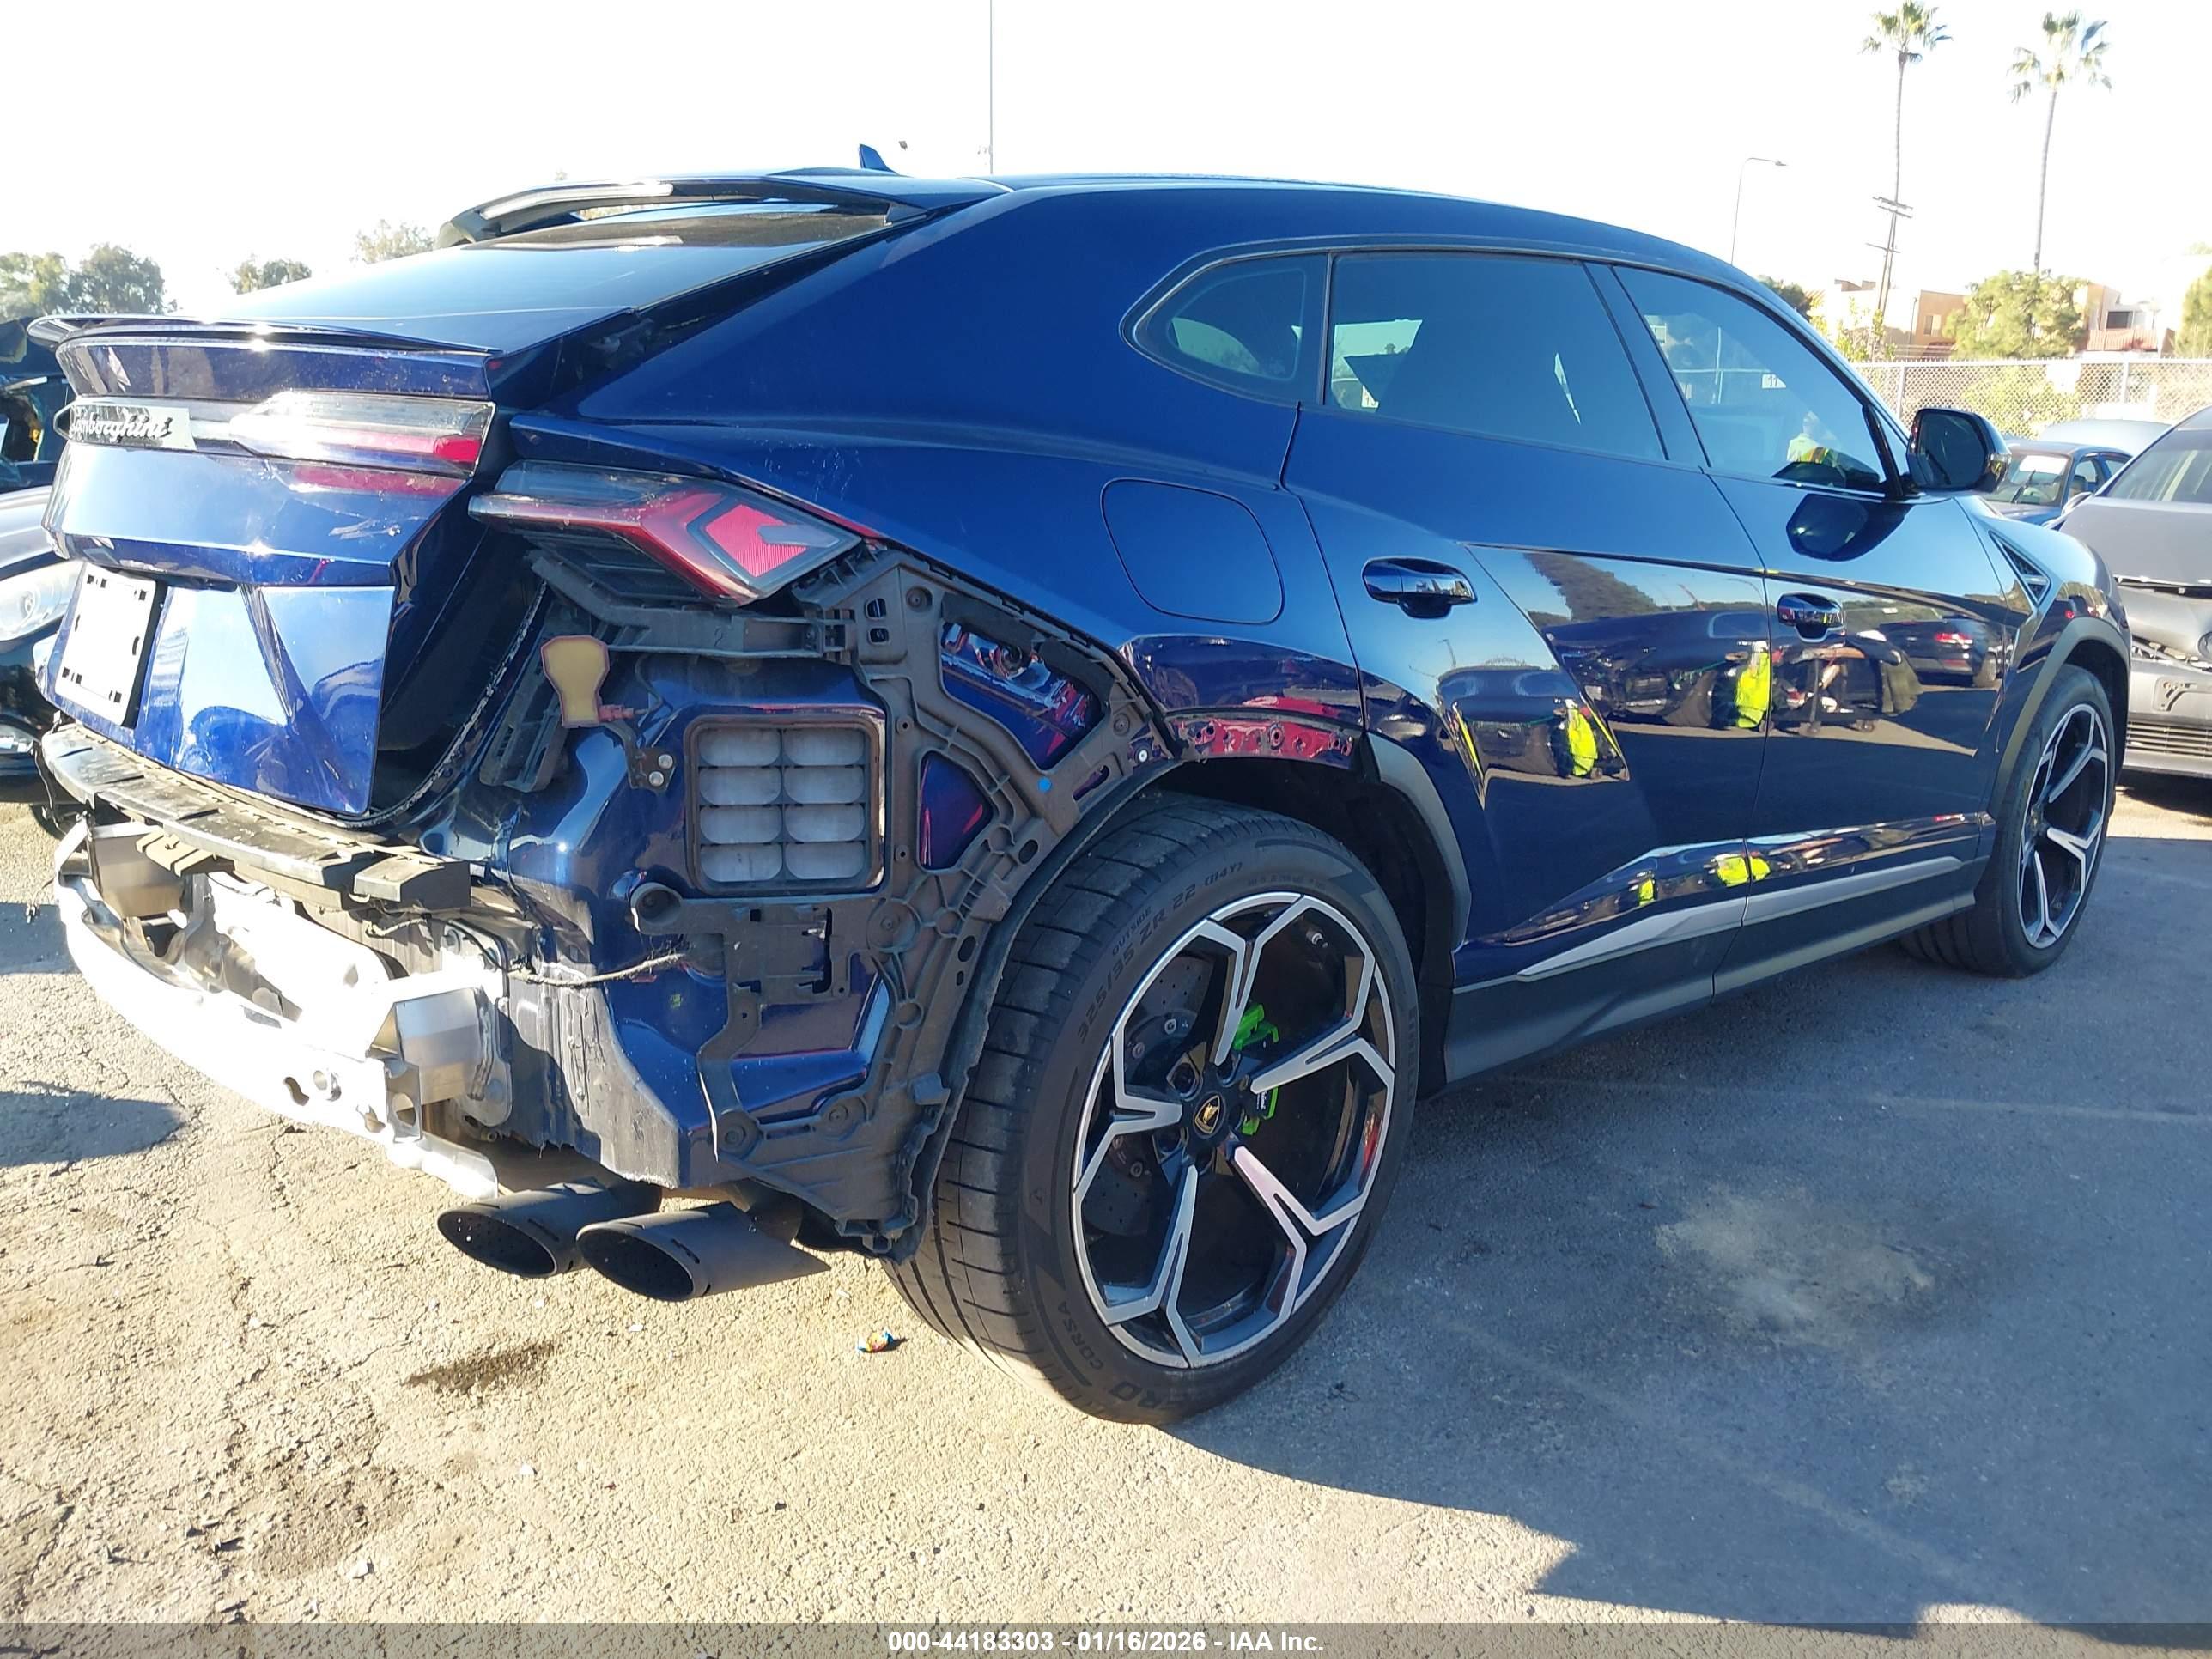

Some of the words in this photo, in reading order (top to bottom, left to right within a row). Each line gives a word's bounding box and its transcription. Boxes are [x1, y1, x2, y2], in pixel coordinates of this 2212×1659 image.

[1077, 942, 1134, 1045] 325/35
[1139, 908, 1165, 945] ZR
[1173, 884, 1196, 910] 22
[1058, 1301, 1104, 1370] CORSA
